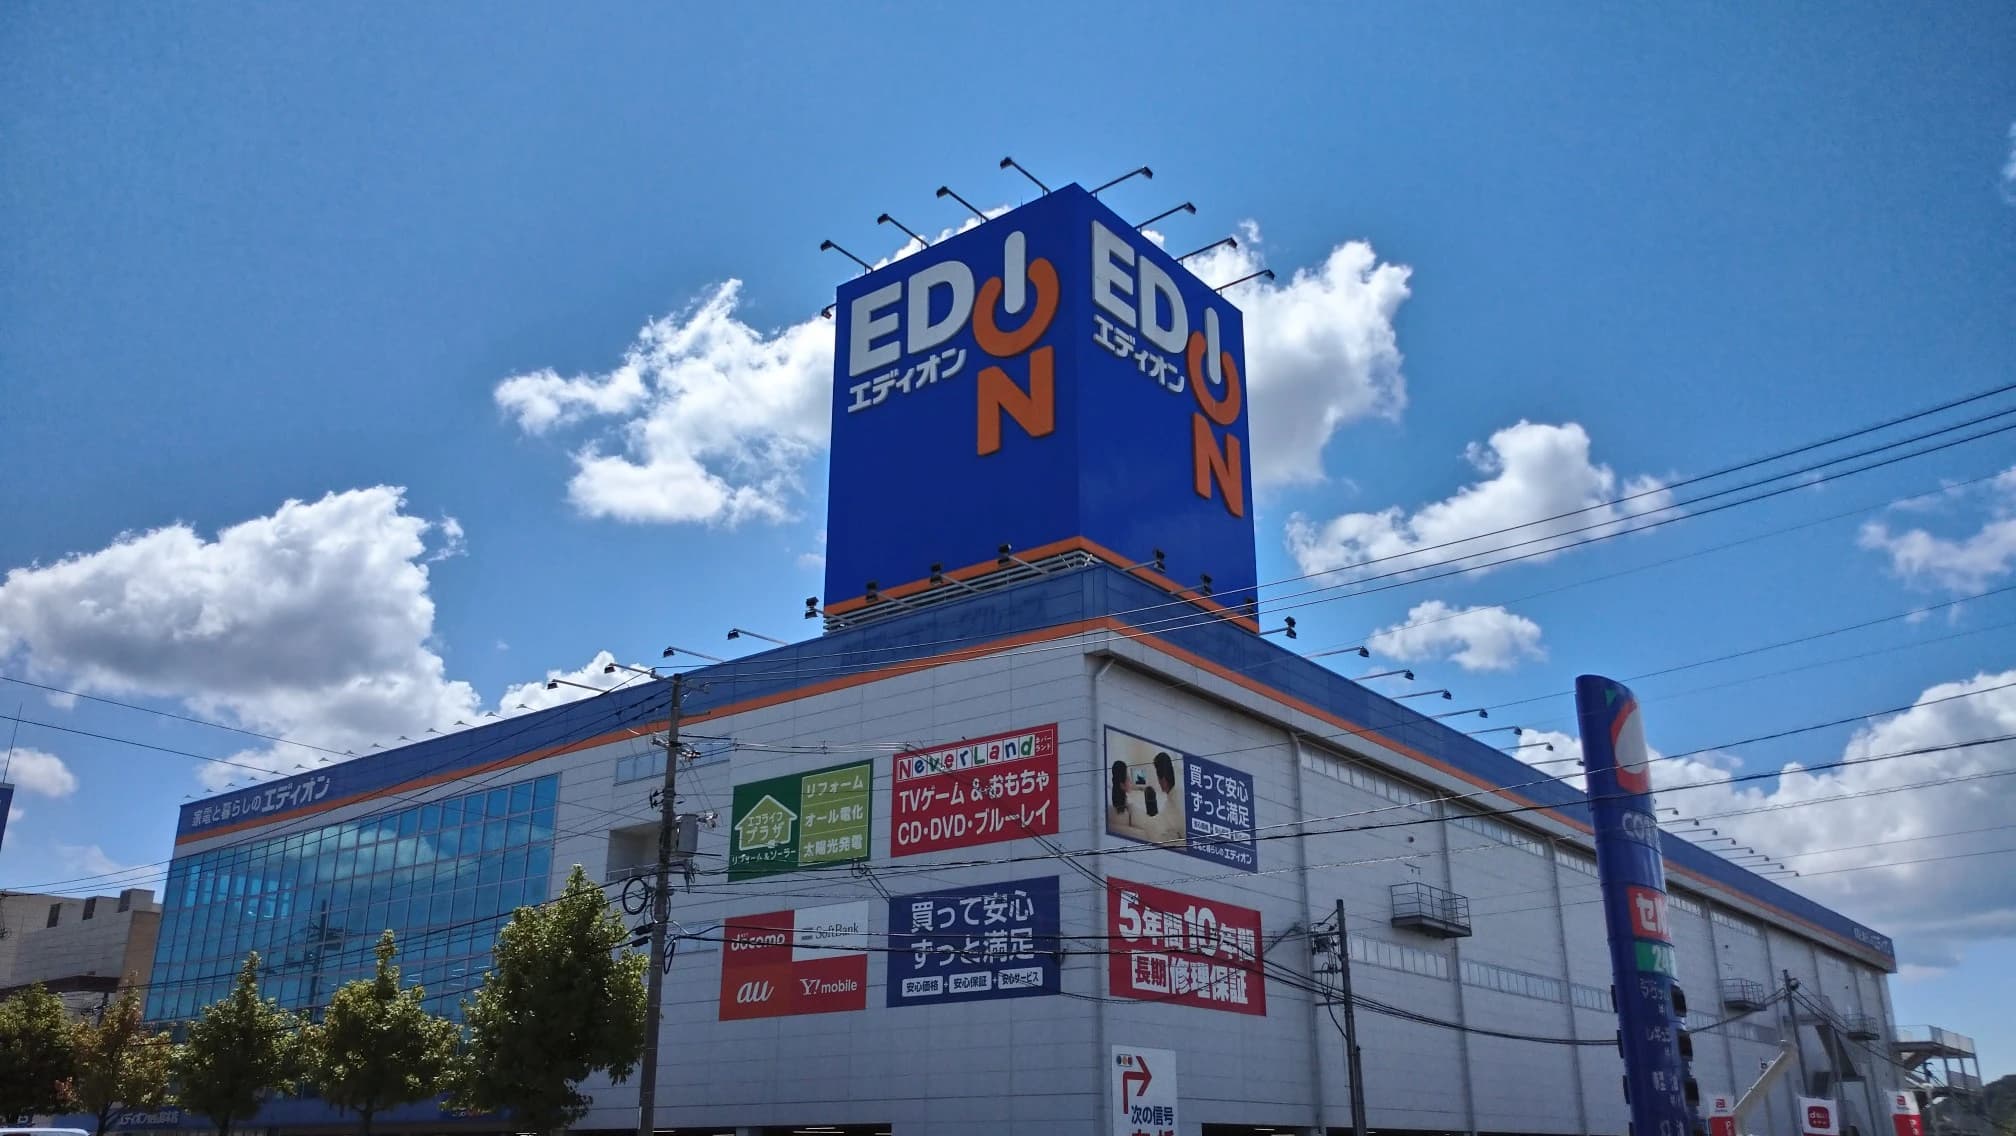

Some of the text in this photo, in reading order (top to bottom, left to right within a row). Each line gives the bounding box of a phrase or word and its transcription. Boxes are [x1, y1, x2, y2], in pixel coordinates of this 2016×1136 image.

[1093, 314, 1185, 393] エディオン
[847, 347, 967, 413] エディオン
[898, 735, 1034, 780] NeverLand
[806, 775, 864, 799] リフォーム
[1189, 763, 1249, 803] 買って安心
[748, 811, 784, 827] エコライフ
[804, 803, 864, 827] オール電化
[1190, 791, 1251, 829] ずっと満足
[746, 820, 785, 843] プラザ
[803, 833, 863, 858] 太陽光発電
[911, 889, 1035, 933] 買って安心
[731, 933, 785, 952] docomo
[815, 922, 859, 940] SoftBank
[911, 927, 1035, 970] ずっと満足
[736, 980, 775, 1004] au
[906, 971, 1040, 993] 安心価格 安心保証 安心サービス
[1131, 1104, 1175, 1126] 次の信号
